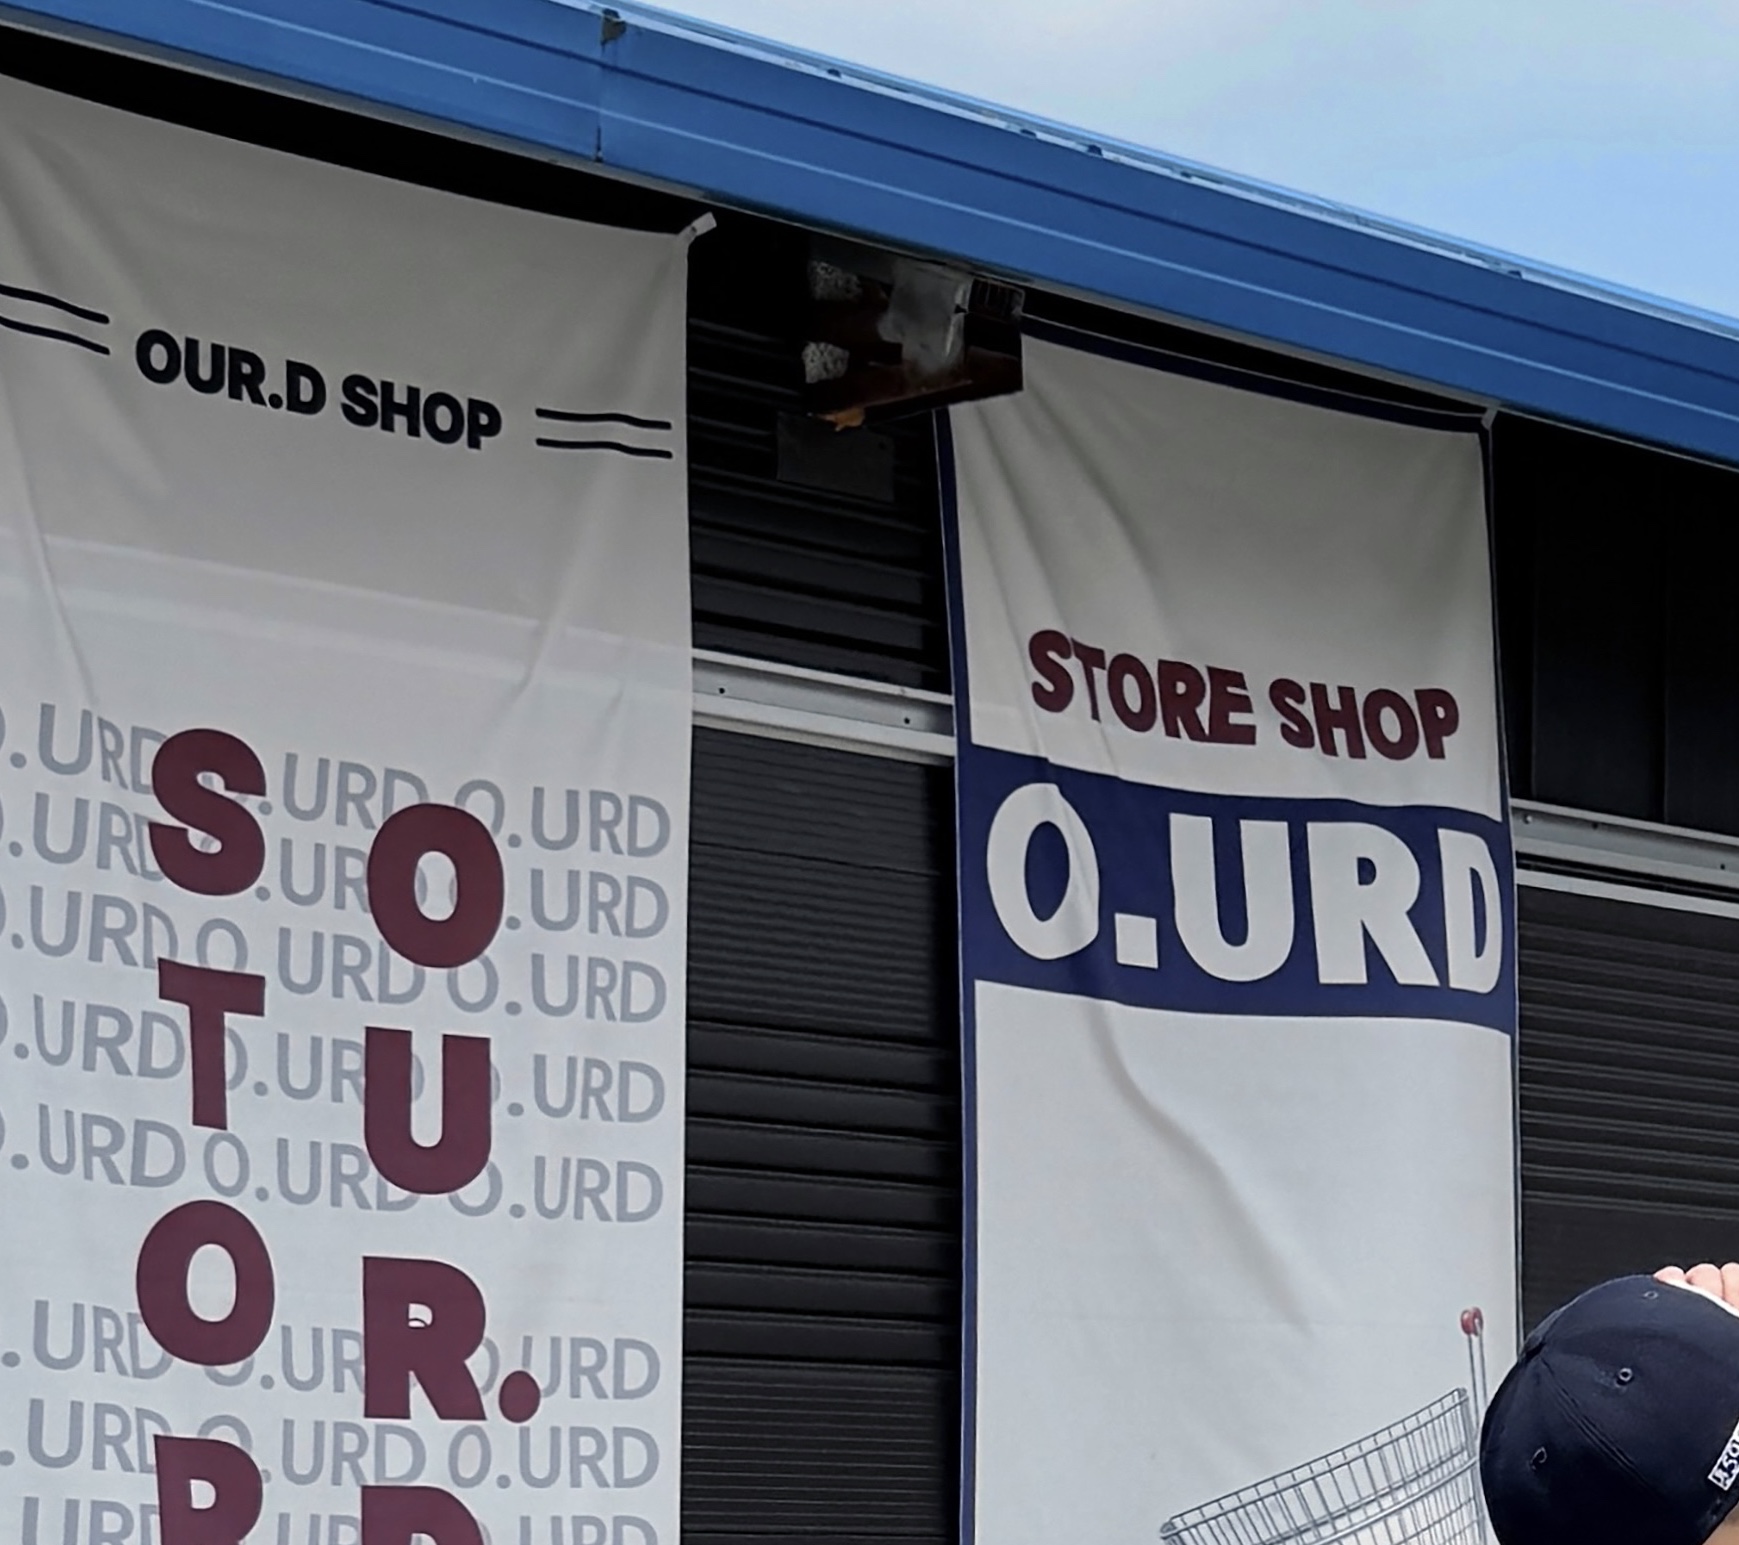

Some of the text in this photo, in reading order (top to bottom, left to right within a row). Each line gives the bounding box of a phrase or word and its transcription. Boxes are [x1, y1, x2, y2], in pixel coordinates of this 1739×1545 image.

[134, 328, 503, 450] OUR.D SHOP
[1027, 629, 1460, 760] STORE SHOP
[0, 885, 178, 970] .URD
[986, 782, 1503, 994] O.URD
[0, 993, 186, 1080] .URD
[0, 1102, 187, 1189] .URD
[447, 1424, 660, 1490] O.URD
